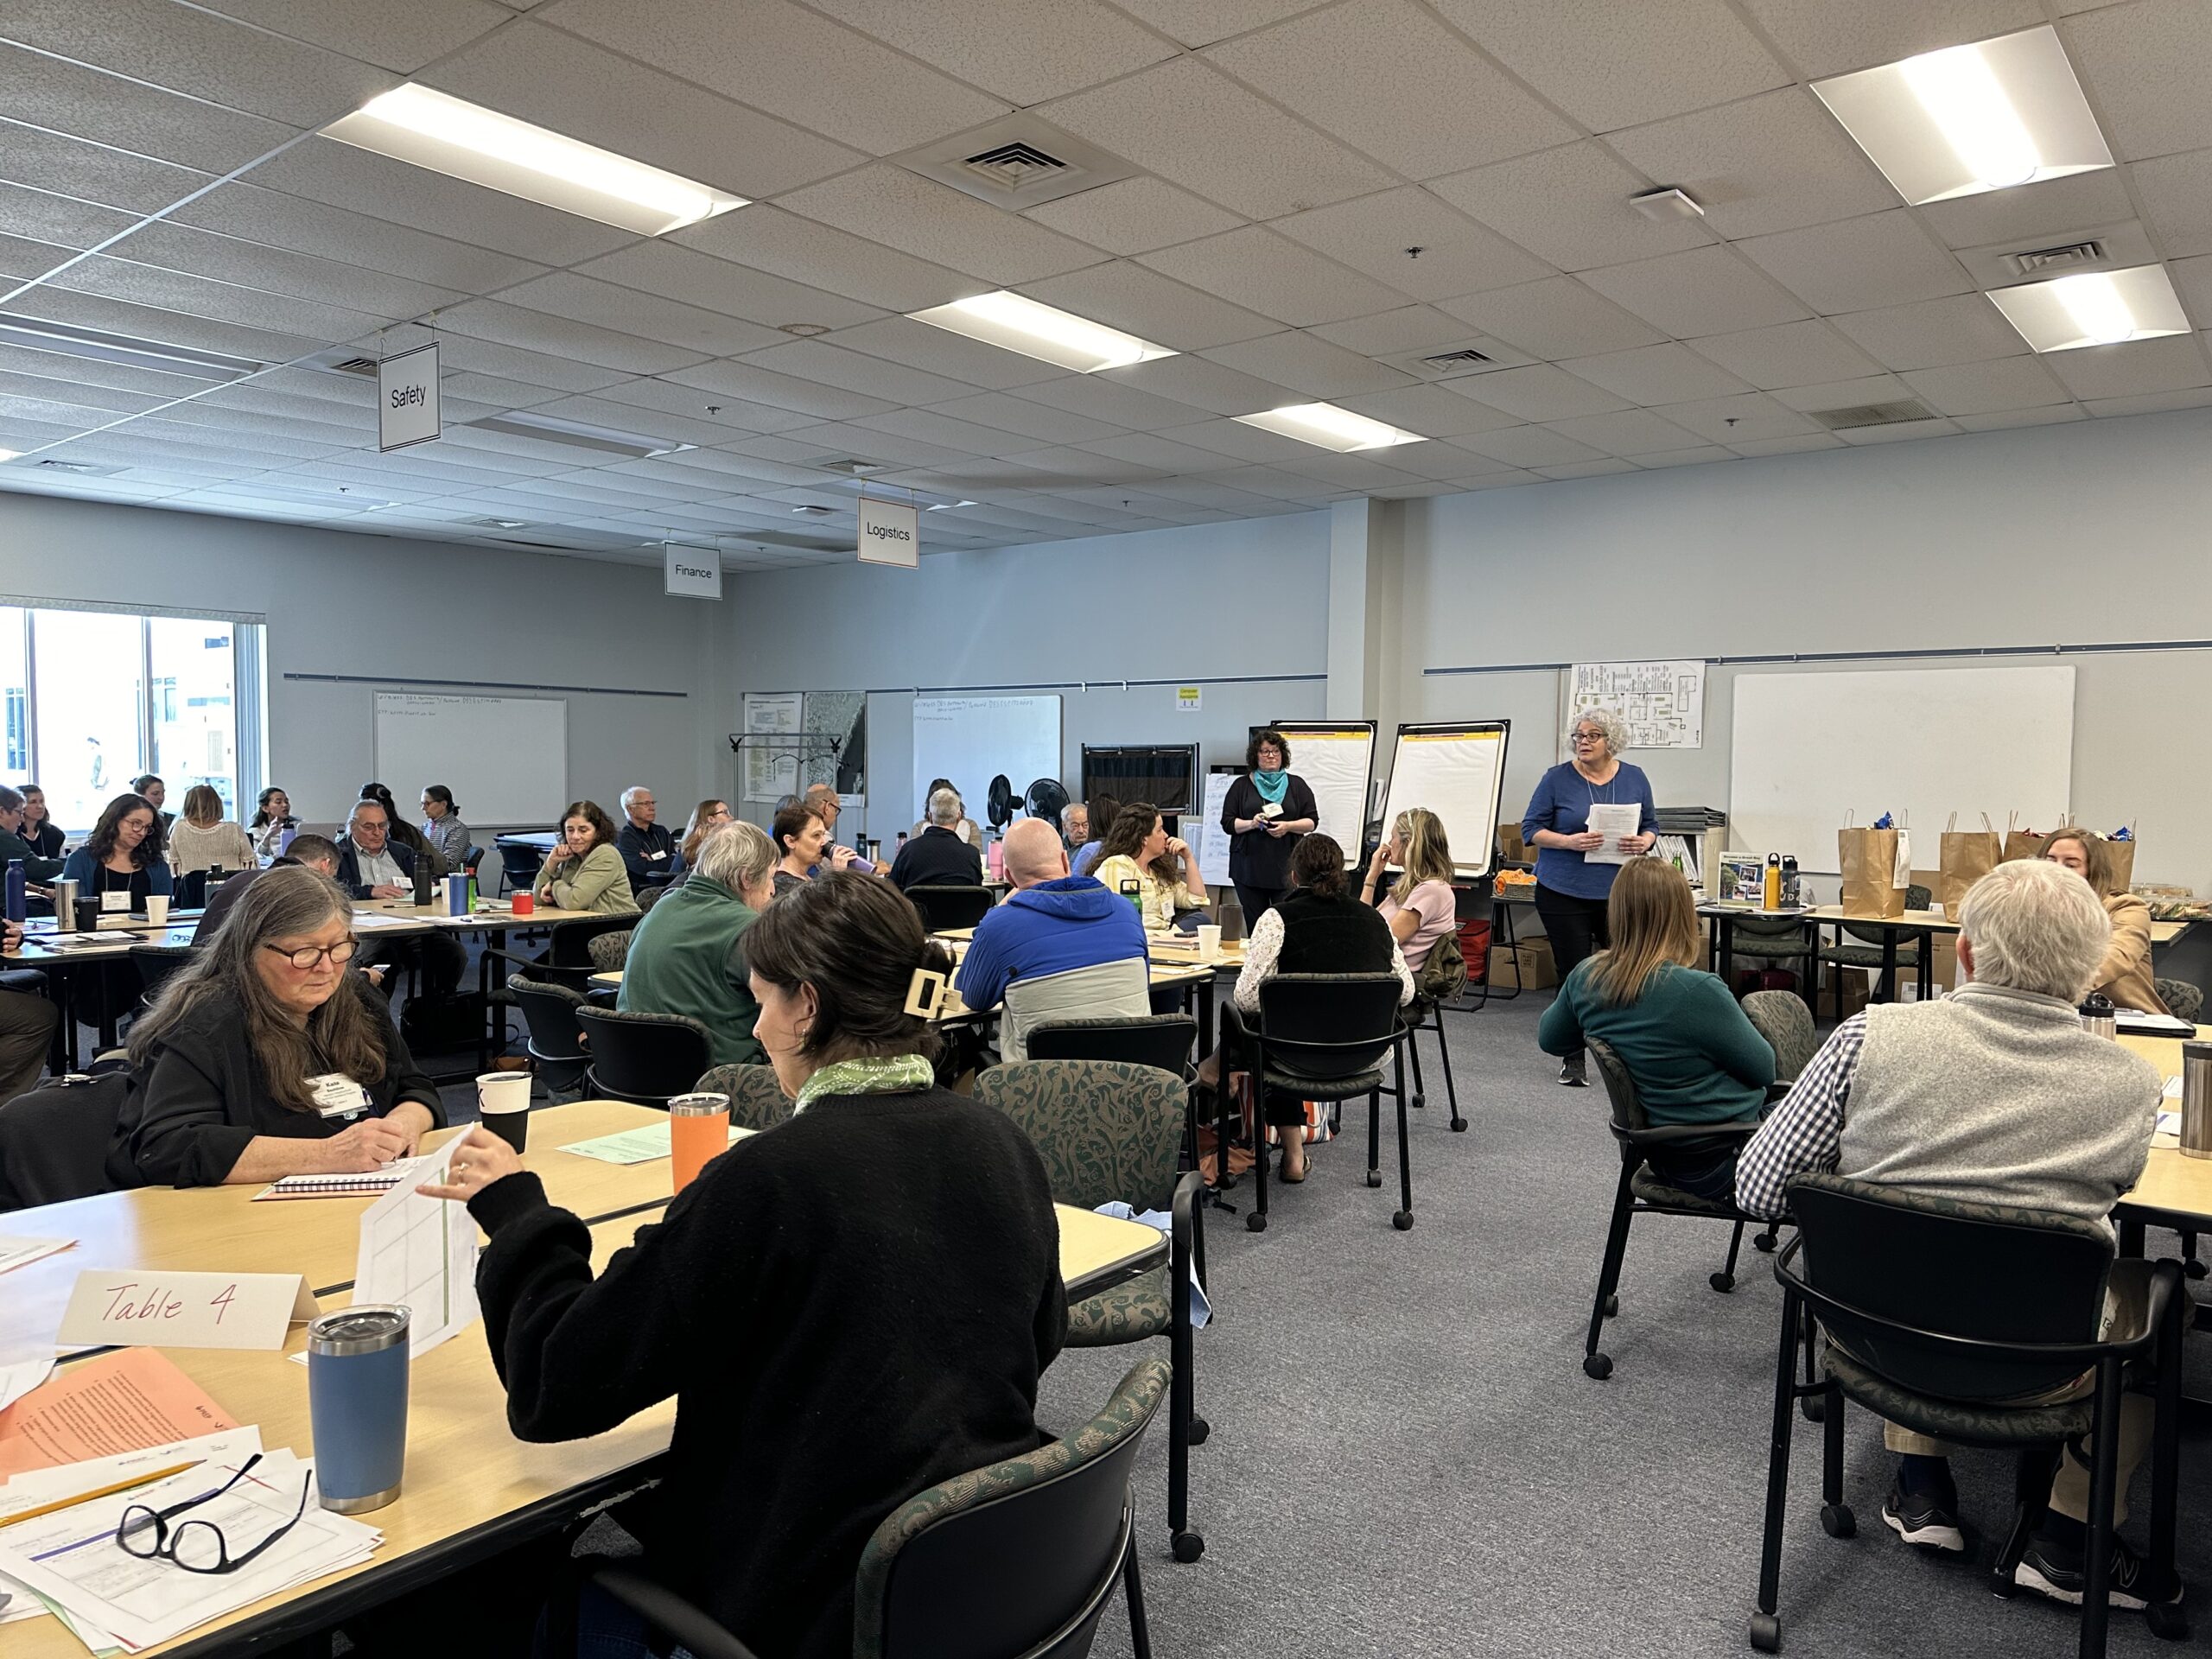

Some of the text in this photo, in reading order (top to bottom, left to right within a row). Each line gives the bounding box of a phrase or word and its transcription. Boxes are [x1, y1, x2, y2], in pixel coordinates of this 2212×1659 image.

[391, 384, 426, 409] Safety
[867, 521, 910, 541] Logistics
[675, 564, 712, 578] Finance
[102, 1284, 235, 1325] Table 4
